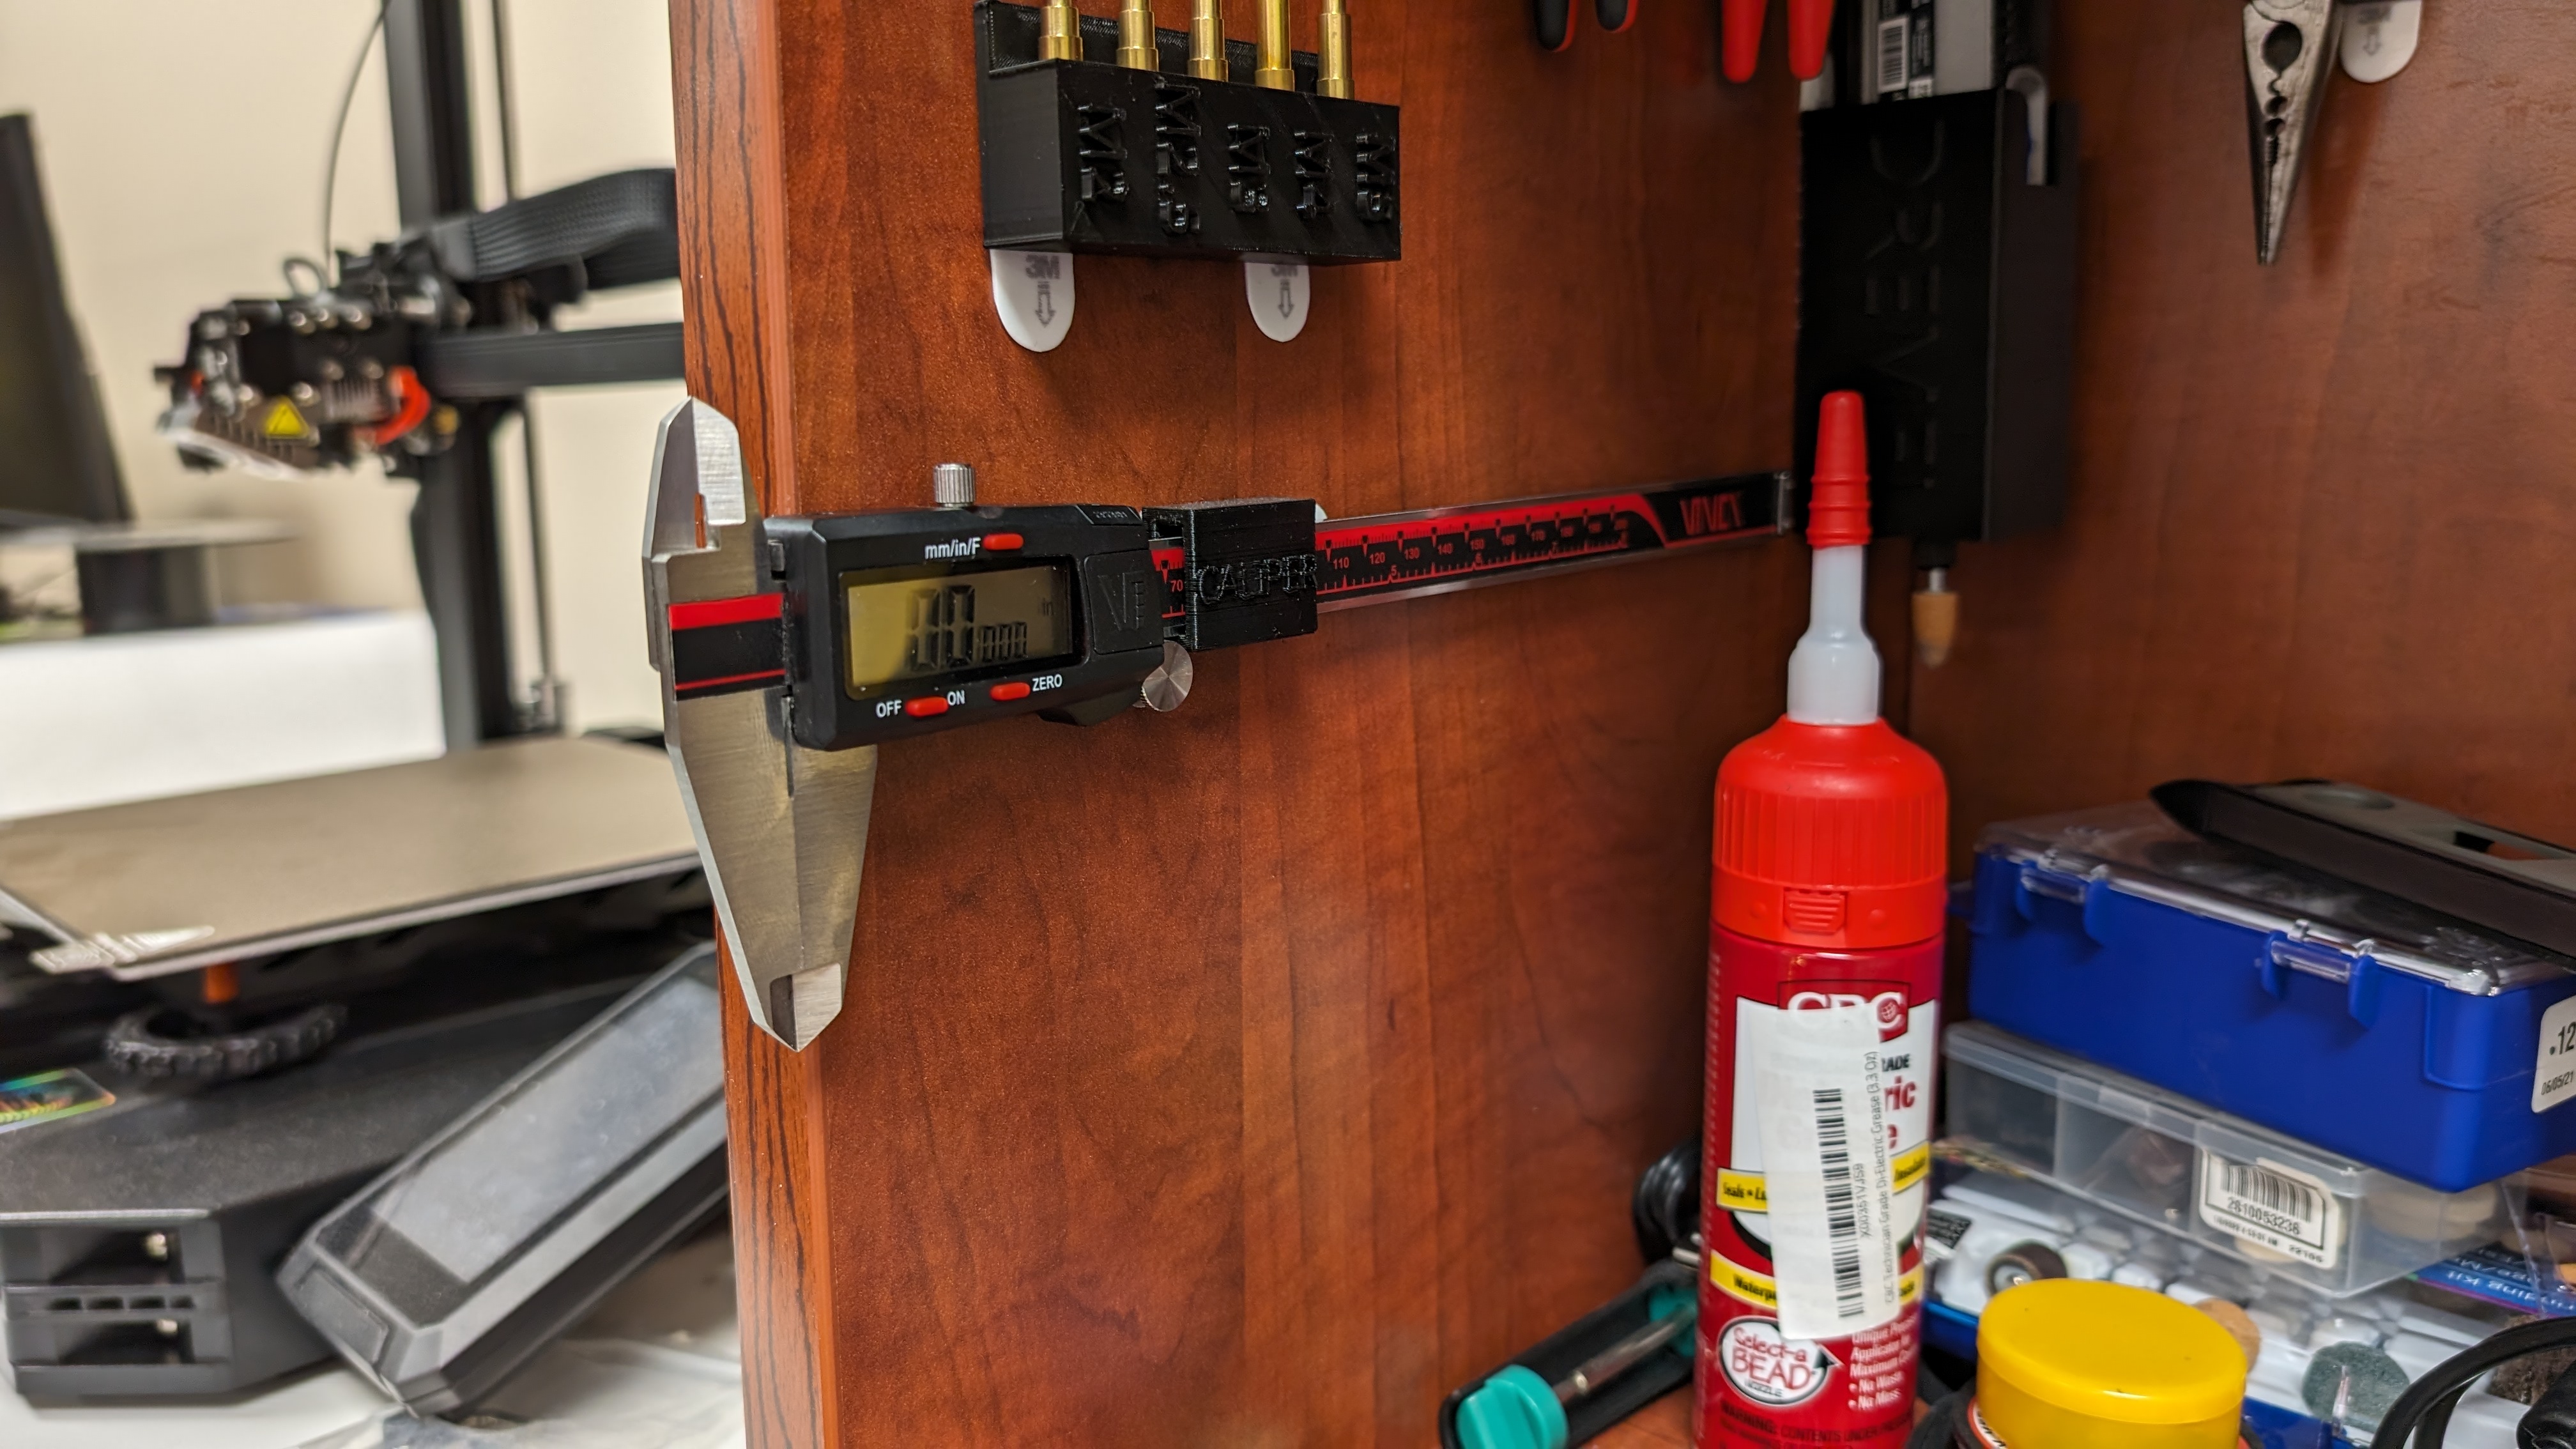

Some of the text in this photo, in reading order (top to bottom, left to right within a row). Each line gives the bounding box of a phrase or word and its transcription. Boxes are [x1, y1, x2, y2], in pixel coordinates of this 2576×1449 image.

[1155, 75, 1201, 234] M2.5
[924, 537, 981, 560] mm/in/F
[1333, 556, 1349, 570] 110
[1369, 551, 1386, 565] 120
[1404, 547, 1420, 560] 130
[1438, 543, 1454, 555] 140
[1470, 538, 1485, 550] 150
[1170, 579, 1184, 593] 70
[1390, 565, 1397, 576] 5
[1032, 673, 1063, 692] ZERO
[875, 690, 965, 718] OFF ON
[1866, 1073, 1881, 1094] (3.3
[1870, 1096, 1883, 1135] Grease
[1873, 1136, 1889, 1189] Di-Electric
[1878, 1190, 1891, 1224] Grade
[1733, 1326, 1807, 1362] Select-a
[1732, 1345, 1812, 1390] BEAD
